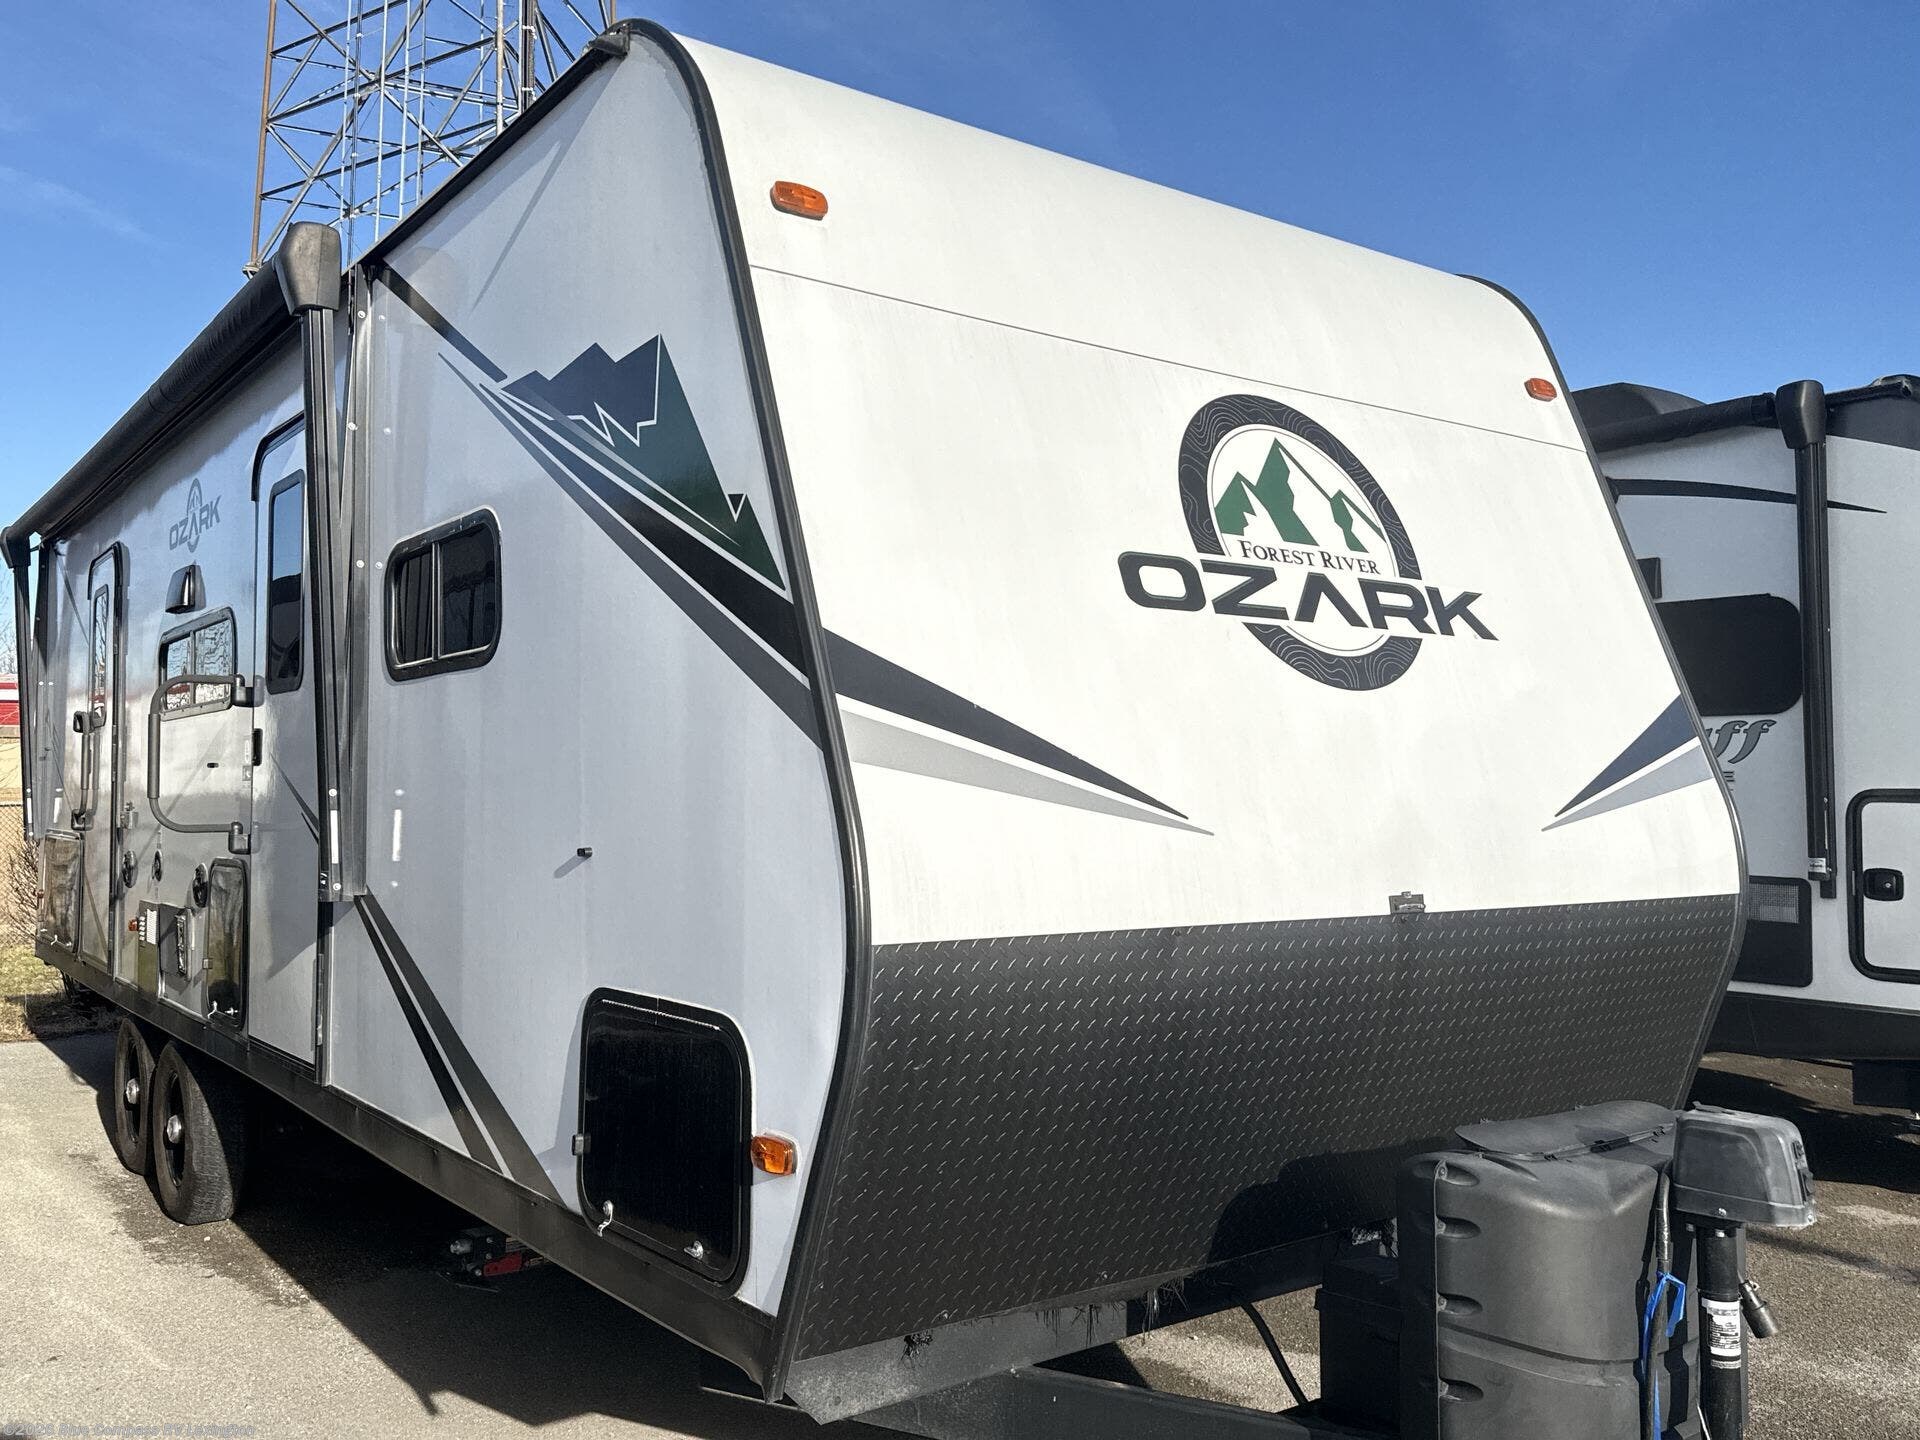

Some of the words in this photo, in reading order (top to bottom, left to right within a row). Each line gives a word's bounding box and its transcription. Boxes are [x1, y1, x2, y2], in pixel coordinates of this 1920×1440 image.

[169, 494, 223, 551] OZARK
[1237, 539, 1316, 567] FOREST
[1319, 544, 1382, 576] RIVER
[1118, 550, 1500, 642] OZARK
